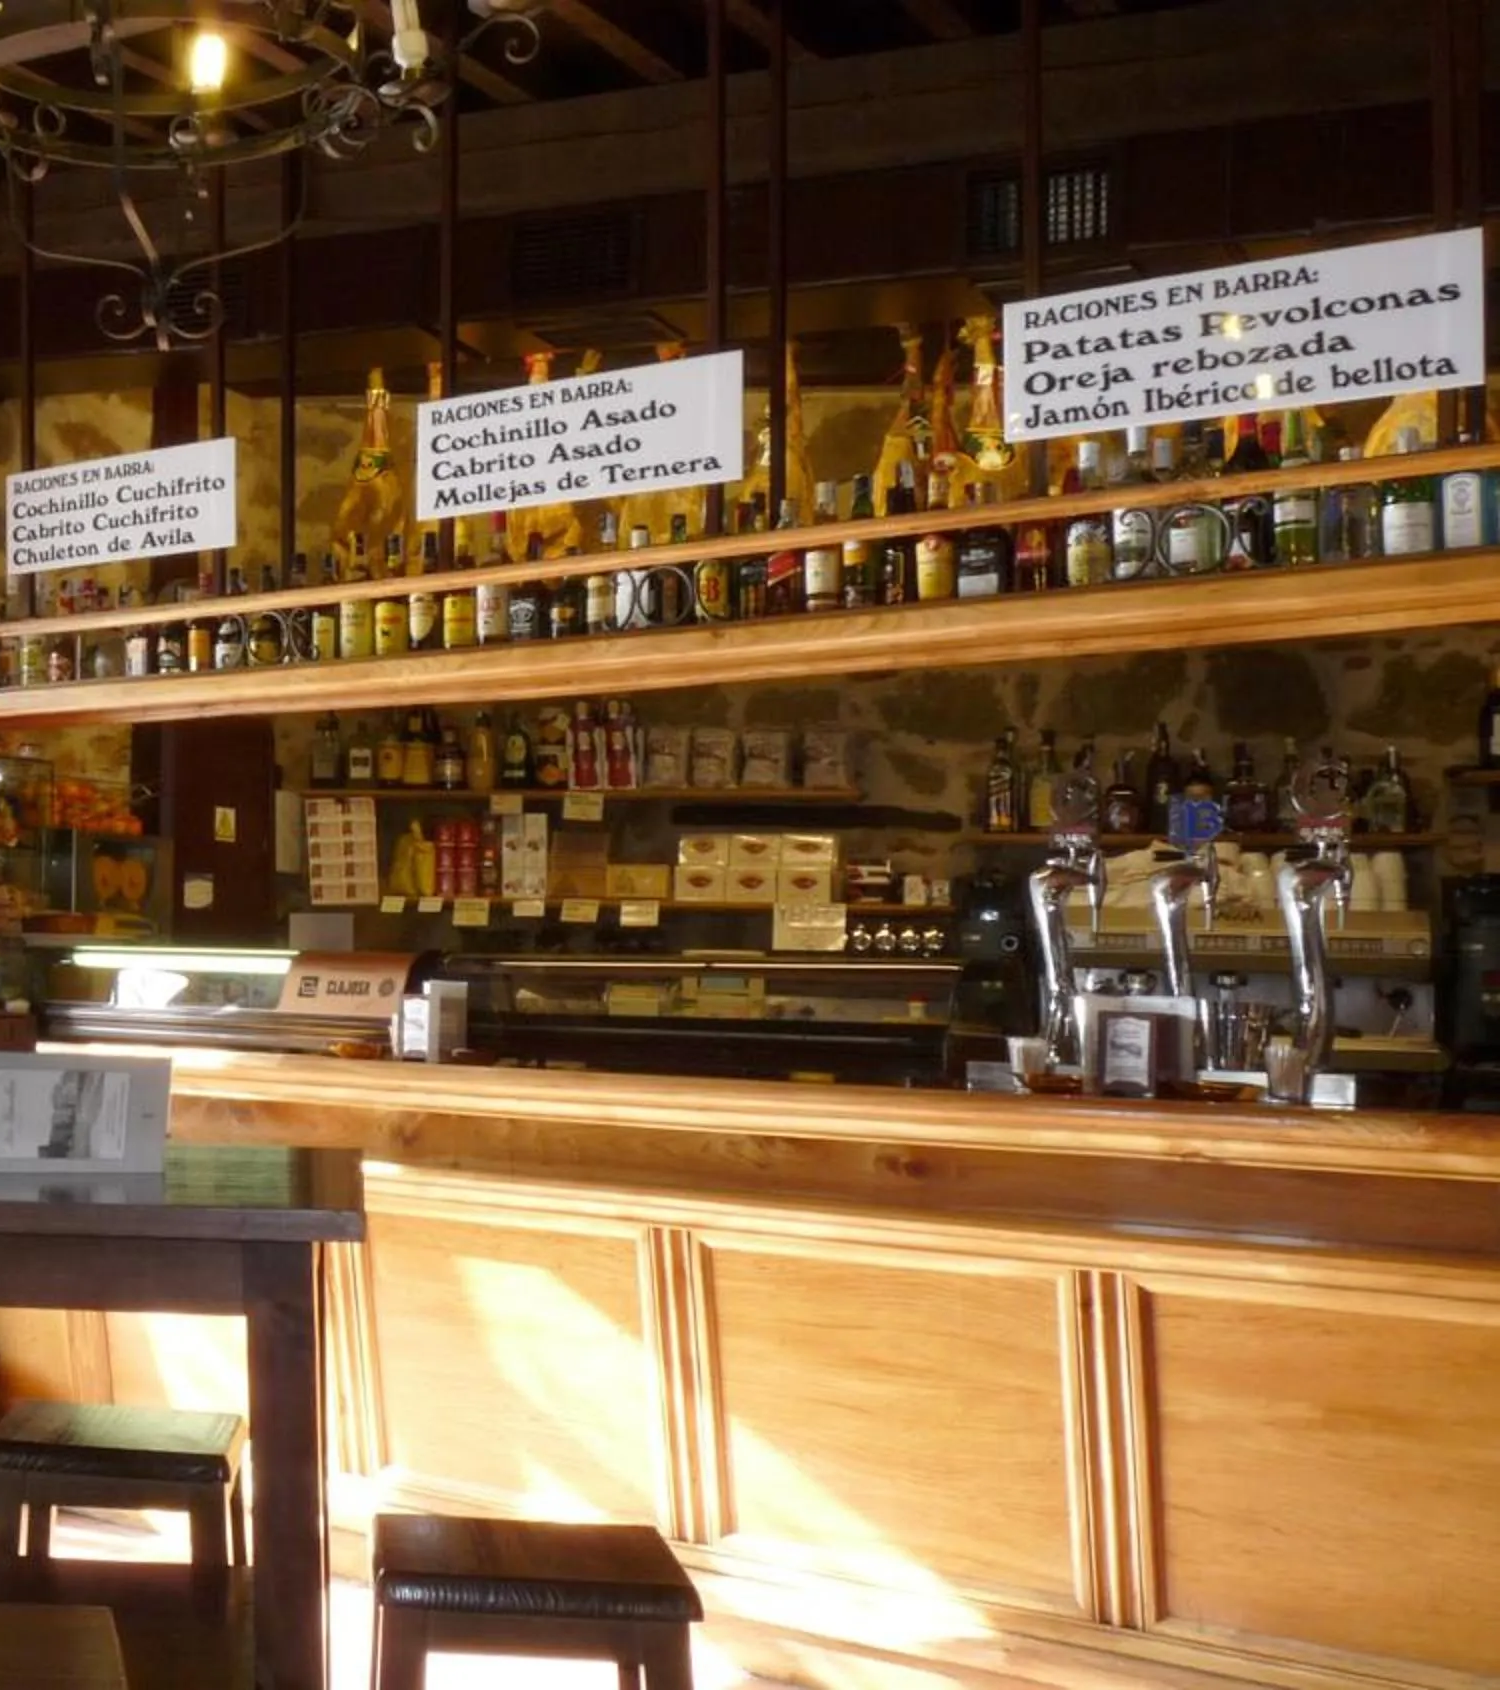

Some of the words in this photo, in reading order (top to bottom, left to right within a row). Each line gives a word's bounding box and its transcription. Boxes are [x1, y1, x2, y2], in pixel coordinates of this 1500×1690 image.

[1022, 322, 1184, 365] Patatas
[1200, 281, 1463, 339] Revolconas
[1024, 291, 1158, 330] RACIONES
[1167, 283, 1205, 308] EN
[1213, 265, 1321, 300] BARRA:
[1023, 364, 1134, 402] Oreja
[1152, 329, 1356, 380] rebozada
[1025, 396, 1131, 430] Jamón
[1143, 379, 1258, 413] Ibérico
[1276, 369, 1315, 397] de
[1330, 352, 1459, 389] bellota
[431, 395, 524, 427] RACIONES
[529, 389, 556, 410] EN
[561, 378, 634, 404] BARRA:
[431, 416, 569, 455] Cochinillo
[579, 399, 678, 432] Asado
[13, 470, 79, 495] RACIONES
[81, 467, 101, 483] EN
[103, 459, 156, 482] BARRA:
[431, 451, 536, 482] Cabrito
[547, 433, 643, 466] Asado
[432, 478, 547, 510] Mollejas
[556, 471, 589, 492] de
[600, 455, 723, 485] Ternera
[12, 492, 110, 520] Cochinillo
[115, 475, 226, 504] Cuchifrito
[12, 518, 86, 544] Cabrito
[92, 503, 200, 532] Cuchifrito
[12, 543, 100, 567] Chuleton
[106, 535, 132, 553] de
[140, 527, 195, 550] Avila
